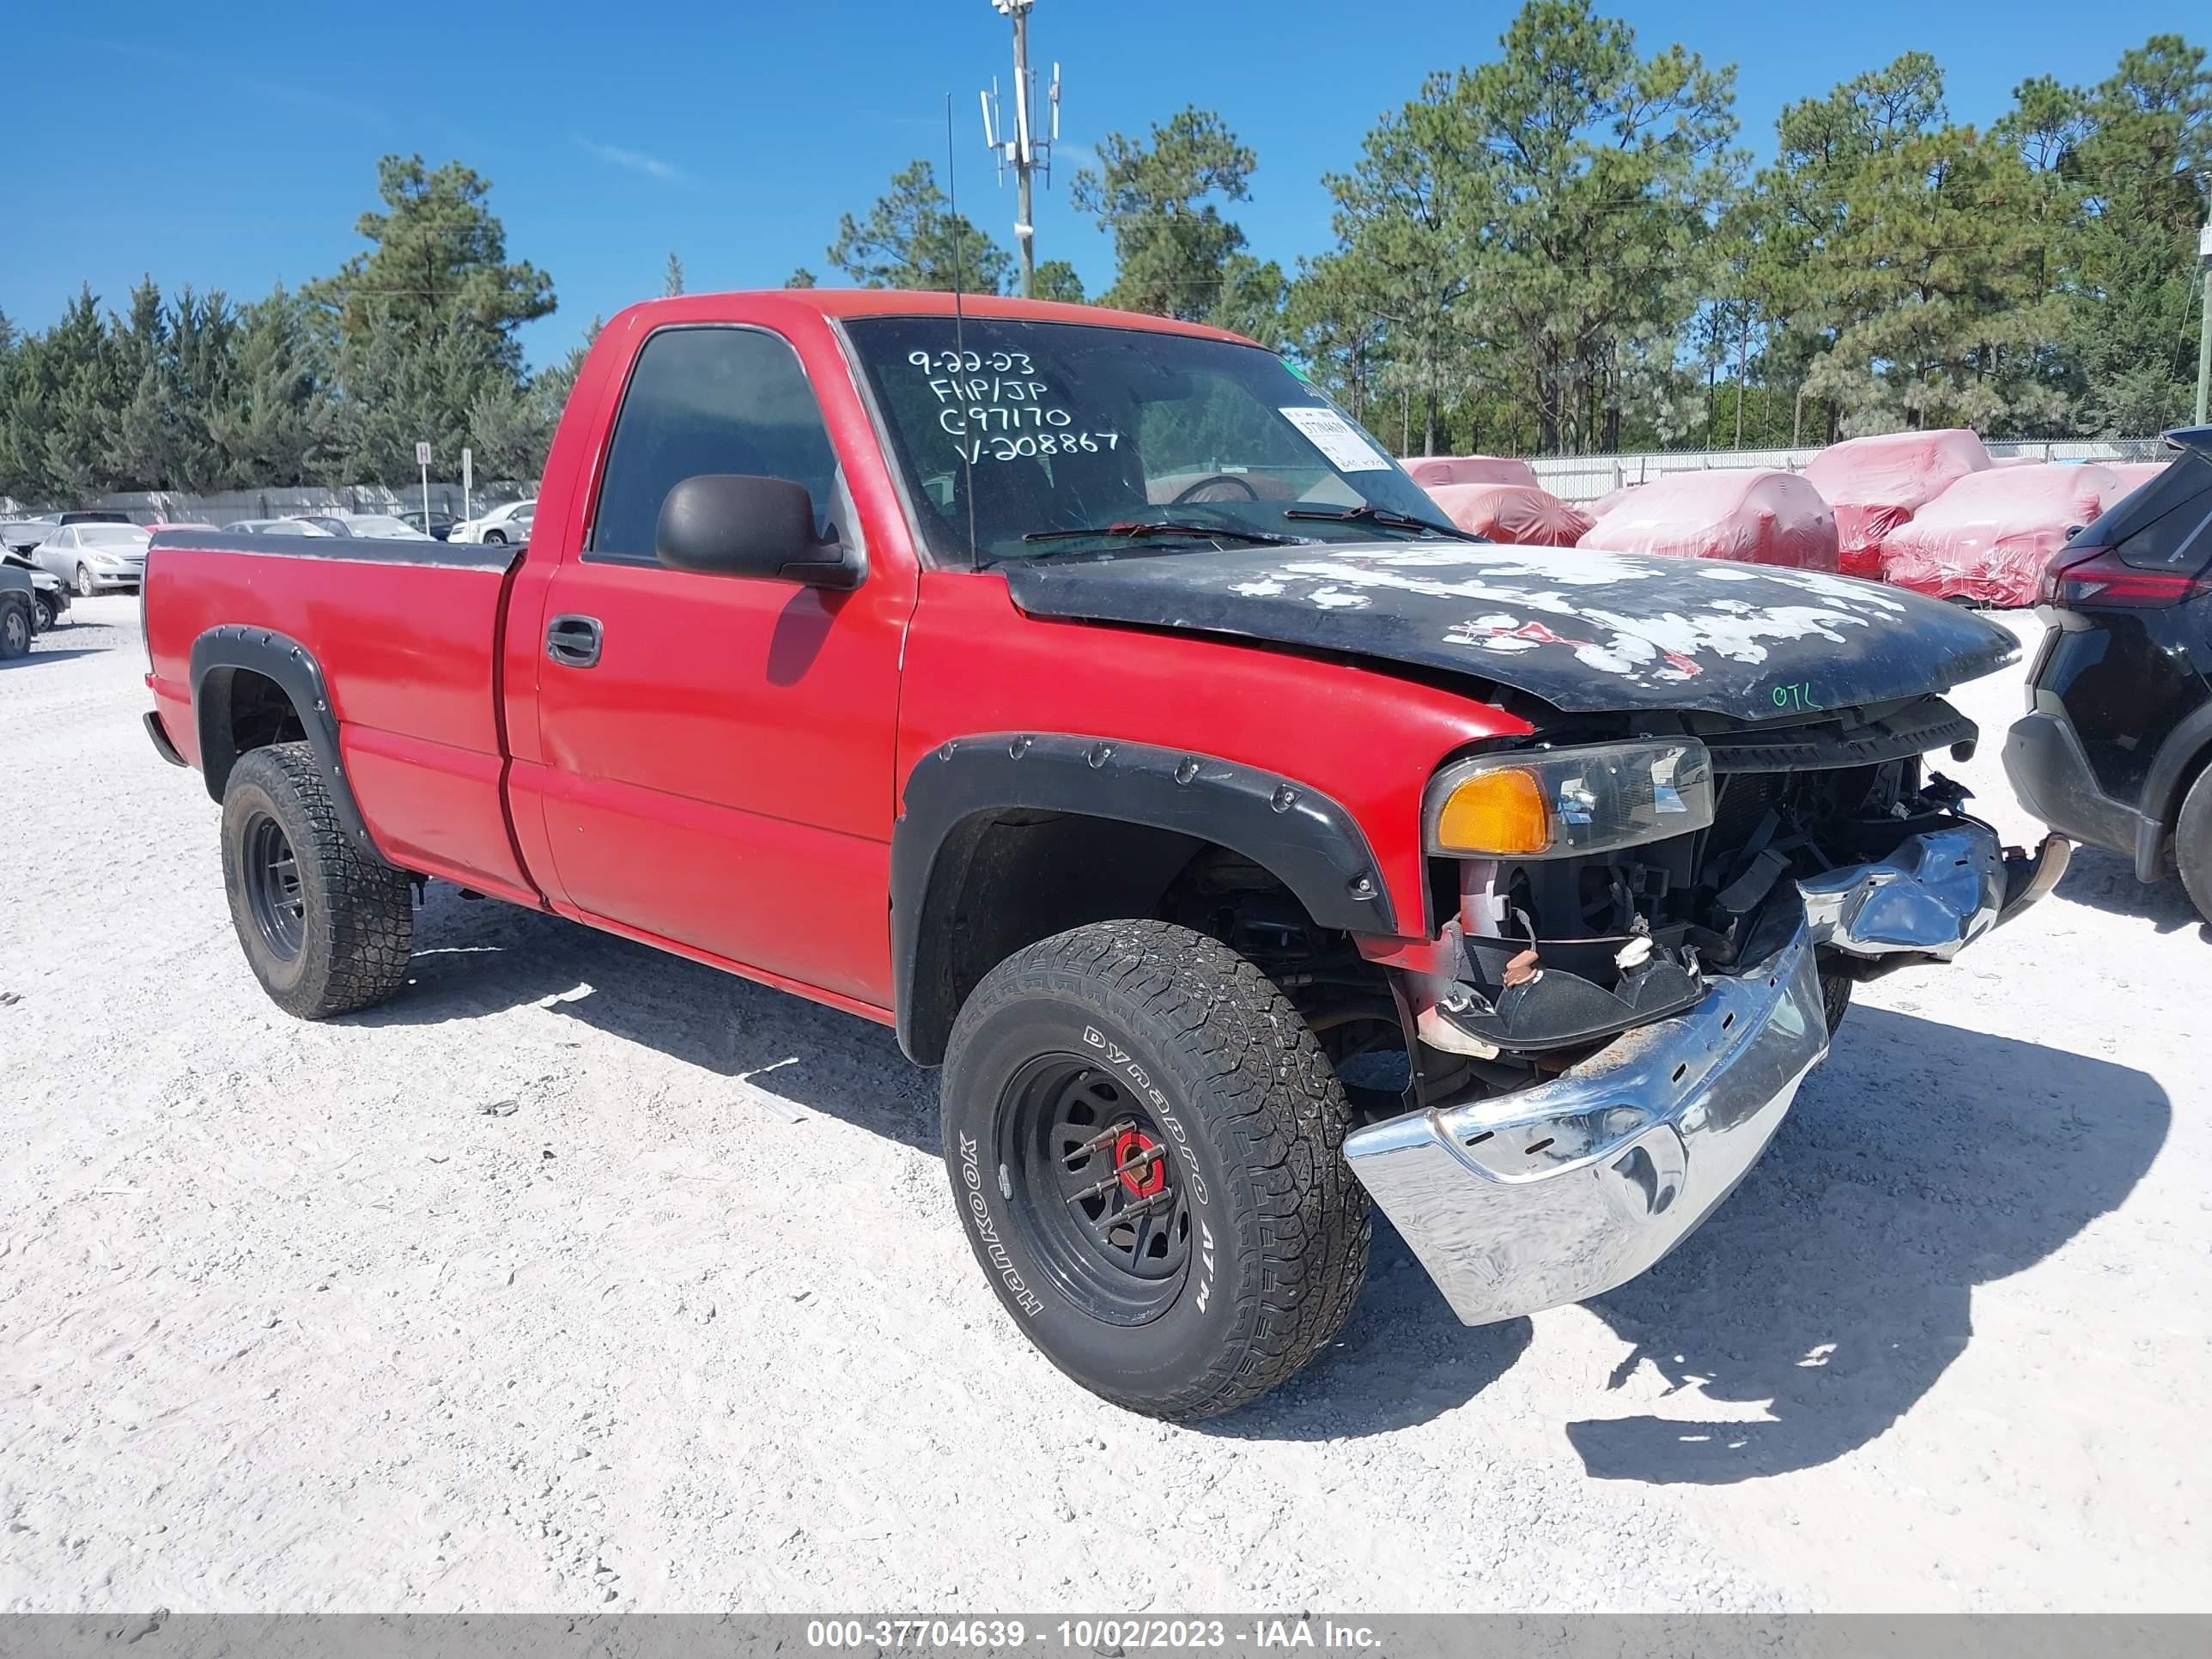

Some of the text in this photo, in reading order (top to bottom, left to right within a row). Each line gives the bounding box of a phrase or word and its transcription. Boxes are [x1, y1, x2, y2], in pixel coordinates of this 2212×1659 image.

[908, 351, 1035, 375] 9-22-23
[929, 377, 1048, 403] FHP/JP
[954, 432, 1119, 465] V-208867
